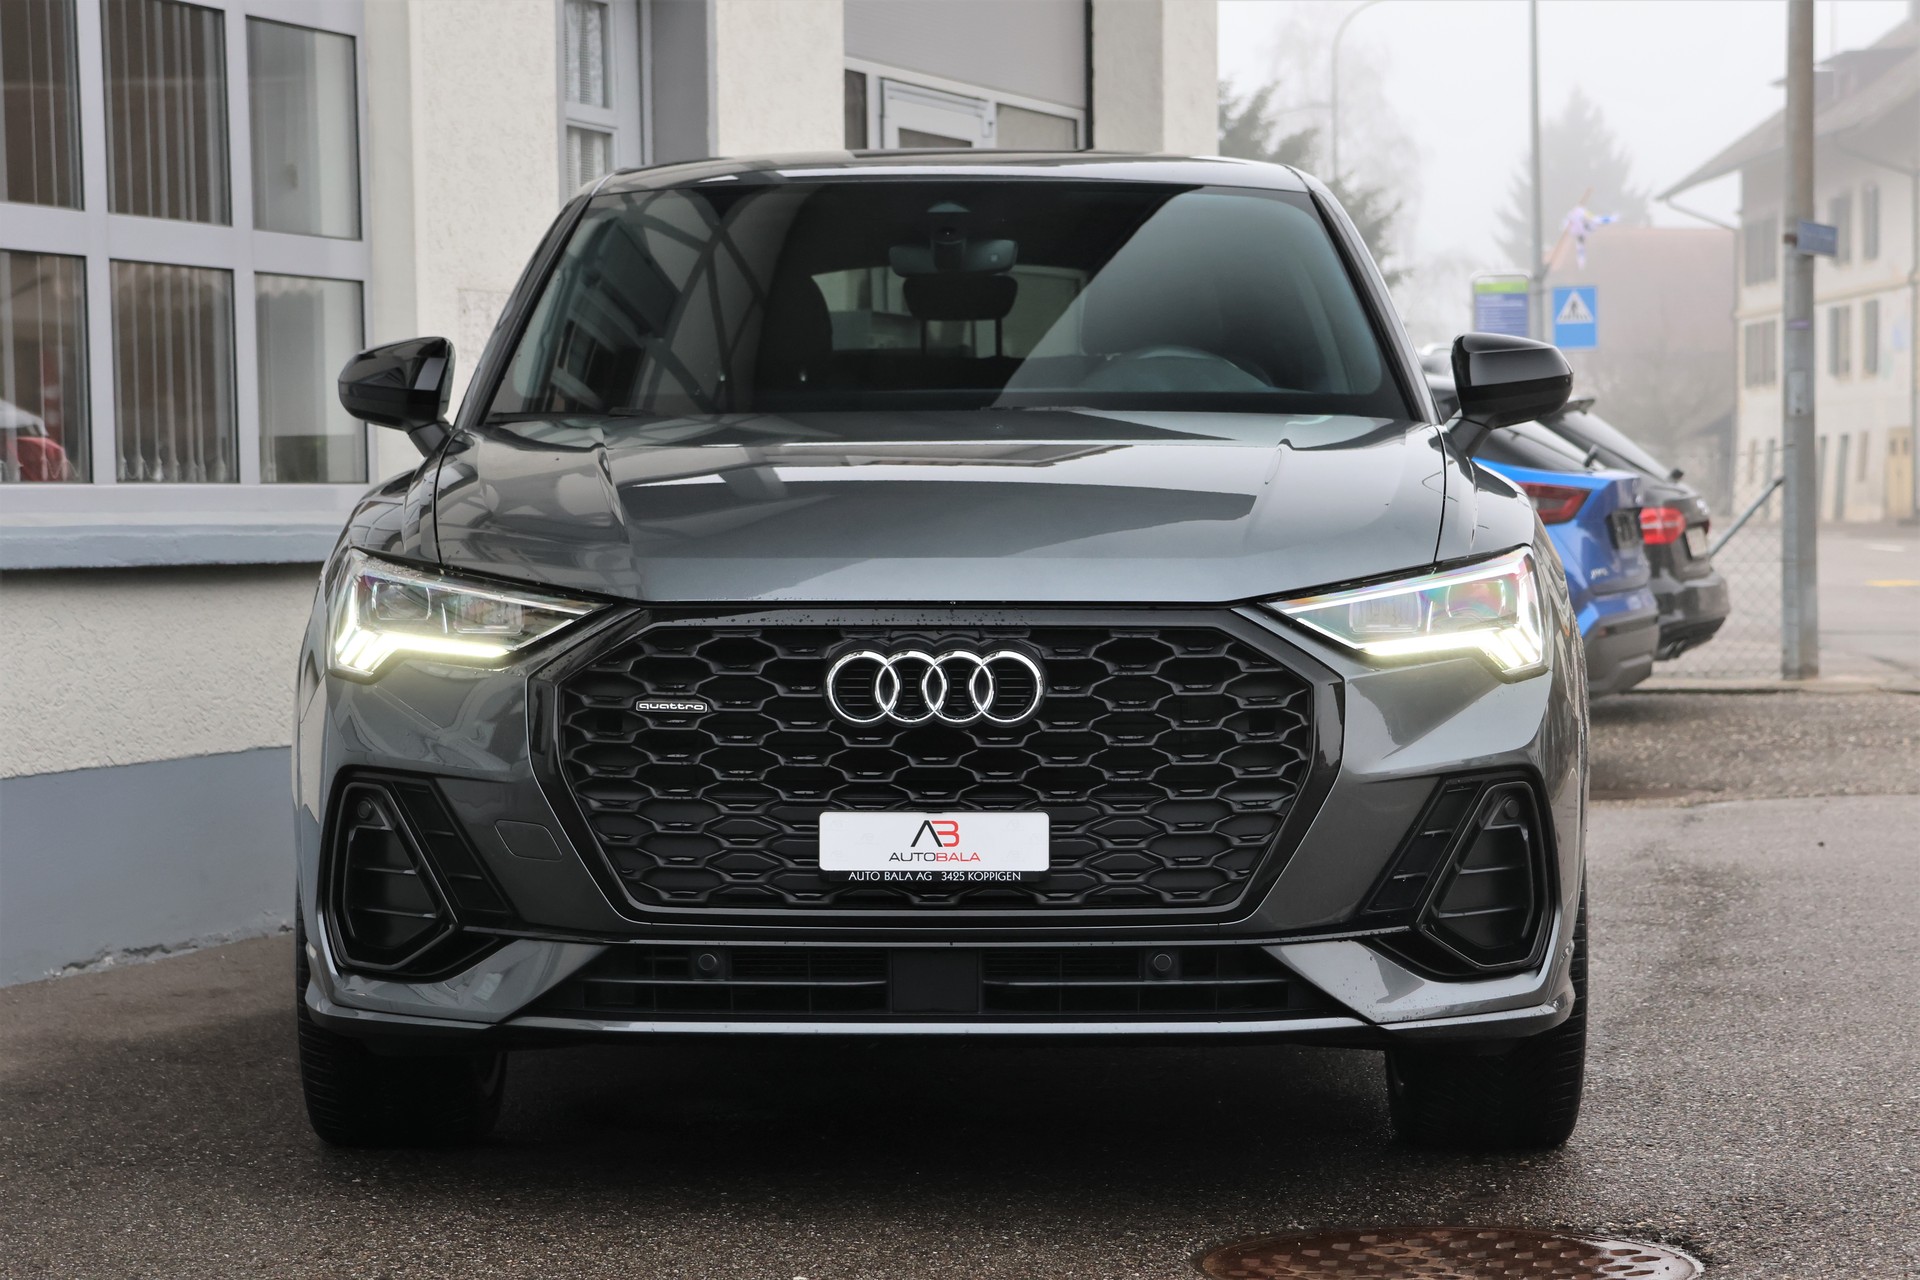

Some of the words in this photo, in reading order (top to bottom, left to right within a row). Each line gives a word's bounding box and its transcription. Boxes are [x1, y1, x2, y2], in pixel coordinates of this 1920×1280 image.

[639, 703, 704, 711] quattro
[910, 820, 960, 848] AB
[888, 852, 981, 862] AUTOBALA
[848, 871, 880, 881] AUTO
[884, 871, 913, 881] BALA
[916, 871, 933, 881] AG
[941, 871, 965, 881] 3425
[968, 871, 1021, 881] KOPPIGEN
